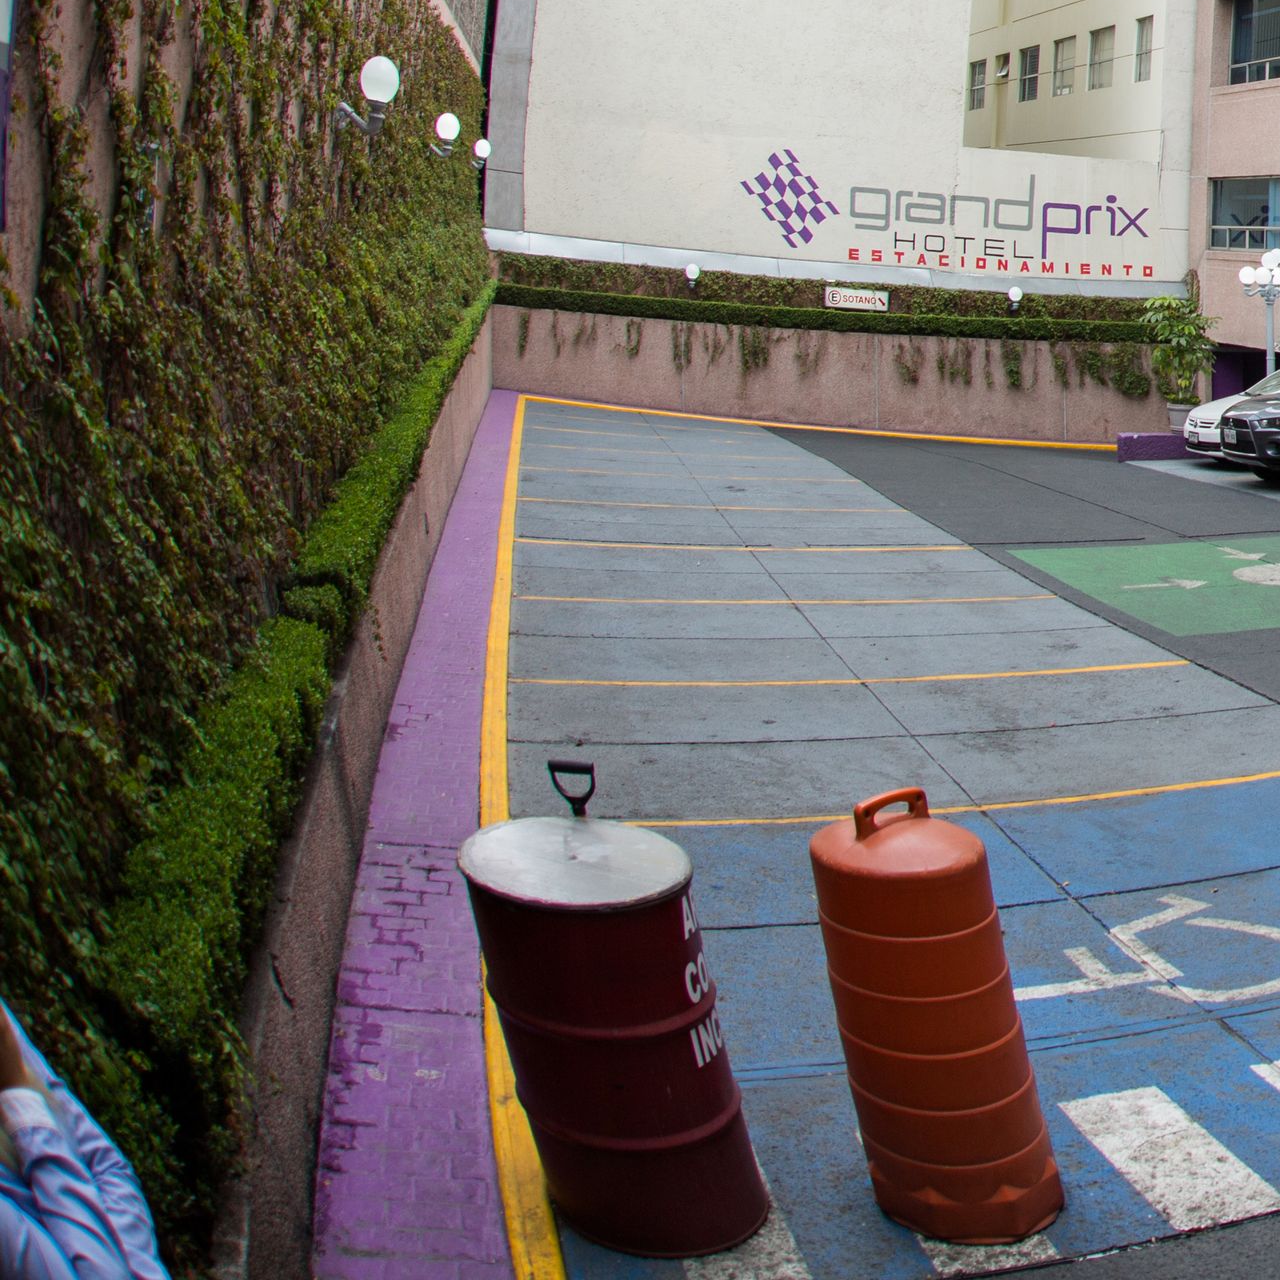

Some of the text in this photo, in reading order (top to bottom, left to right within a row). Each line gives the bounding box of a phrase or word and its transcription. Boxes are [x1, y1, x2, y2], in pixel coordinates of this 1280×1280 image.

[850, 174, 1149, 259] grand prix
[894, 231, 1034, 259] HOTEL
[848, 248, 1153, 277] ESTACIONAMIENTO
[842, 294, 877, 305] SOTANO
